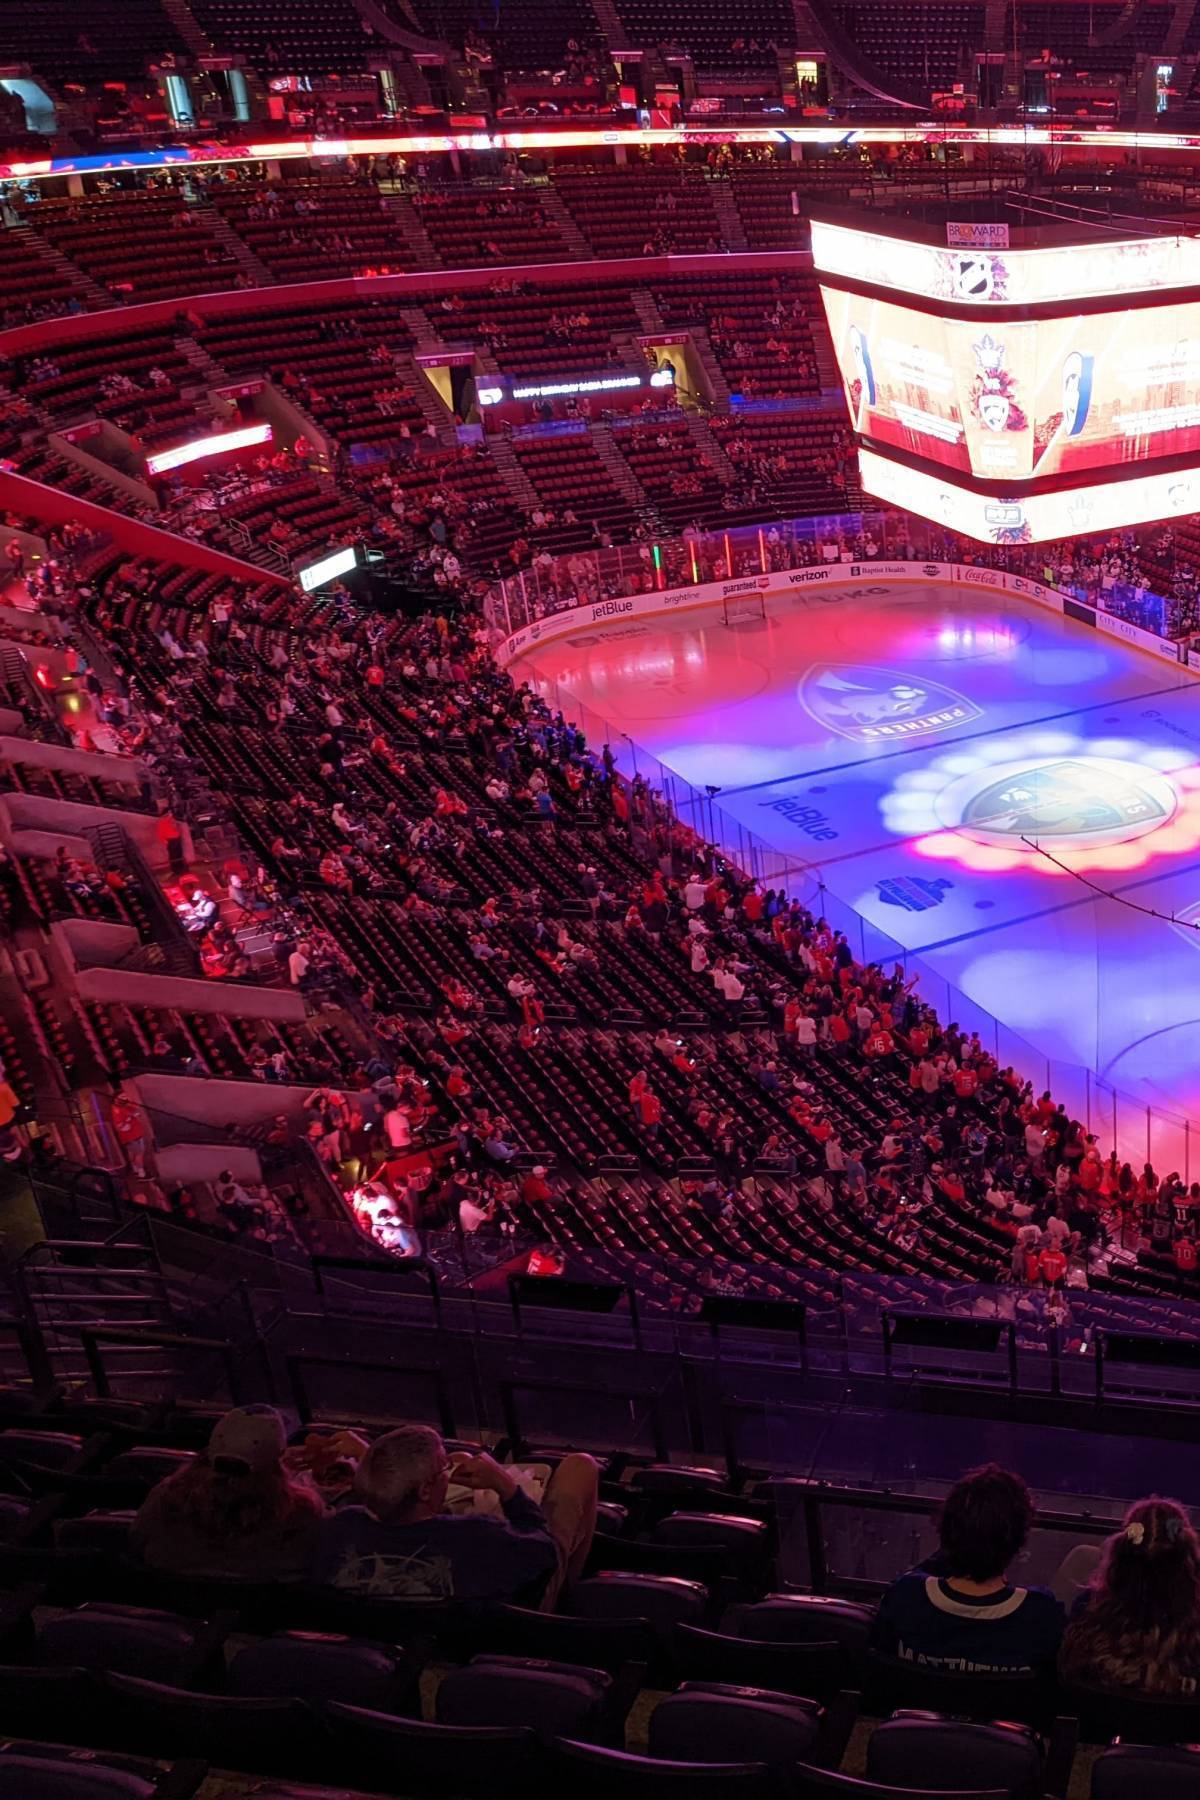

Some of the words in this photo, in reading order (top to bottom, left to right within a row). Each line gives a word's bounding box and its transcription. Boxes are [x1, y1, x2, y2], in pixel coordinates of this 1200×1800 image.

[949, 225, 1006, 238] BROWARD
[789, 568, 829, 583] verizon
[722, 581, 757, 595] guaranteed
[664, 592, 700, 604] brightline
[592, 601, 633, 620] jetBlue
[861, 706, 967, 738] PANTHERS
[758, 795, 839, 841] jetBlue
[1176, 1209, 1187, 1221] 11
[1177, 1248, 1192, 1260] 10
